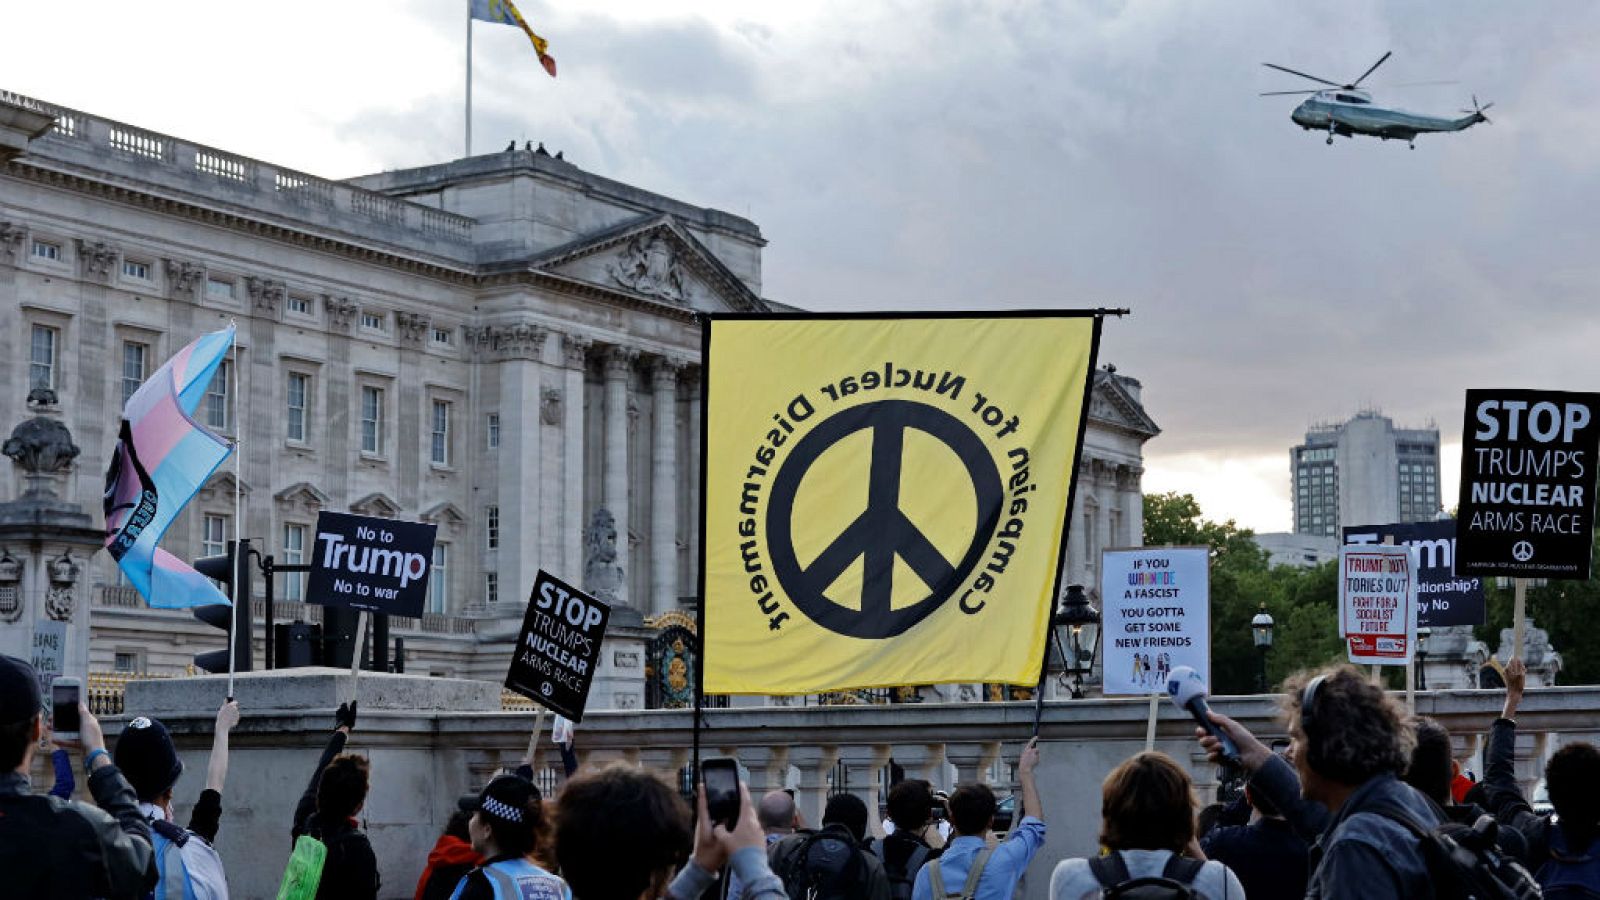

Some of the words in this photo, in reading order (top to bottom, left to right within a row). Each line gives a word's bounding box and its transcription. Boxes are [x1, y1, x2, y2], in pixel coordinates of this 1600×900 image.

[1474, 400, 1591, 443] STOP
[1474, 448, 1585, 479] TRUMP'S
[1471, 482, 1584, 507] NUCLEAR
[1469, 511, 1524, 533] ARMS
[1531, 513, 1582, 535] RACE
[356, 526, 376, 540] No
[380, 529, 394, 543] to
[318, 532, 426, 589] Trump
[1133, 559, 1143, 569] IF
[1145, 558, 1170, 569] YOU
[333, 578, 352, 593] No
[356, 582, 370, 596] to
[374, 587, 399, 600] war
[1124, 590, 1132, 599] A
[1135, 588, 1180, 599] FASCIST
[1347, 577, 1384, 593] TORIES
[1385, 577, 1407, 593] OUT
[536, 580, 603, 632] STOP
[1376, 597, 1391, 608] FOR
[1391, 596, 1398, 608] A
[1432, 599, 1450, 610] No
[1120, 608, 1144, 618] YOU
[1146, 607, 1185, 617] GOTTA
[1356, 609, 1394, 620] SOCIALIST
[1125, 623, 1146, 633] GET
[1148, 622, 1182, 632] SOME
[1115, 638, 1140, 648] NEW
[1143, 637, 1192, 648] FRIENDS
[526, 631, 589, 676] NUCLEAR
[520, 651, 552, 676] ARMS
[553, 668, 583, 693] RACE
